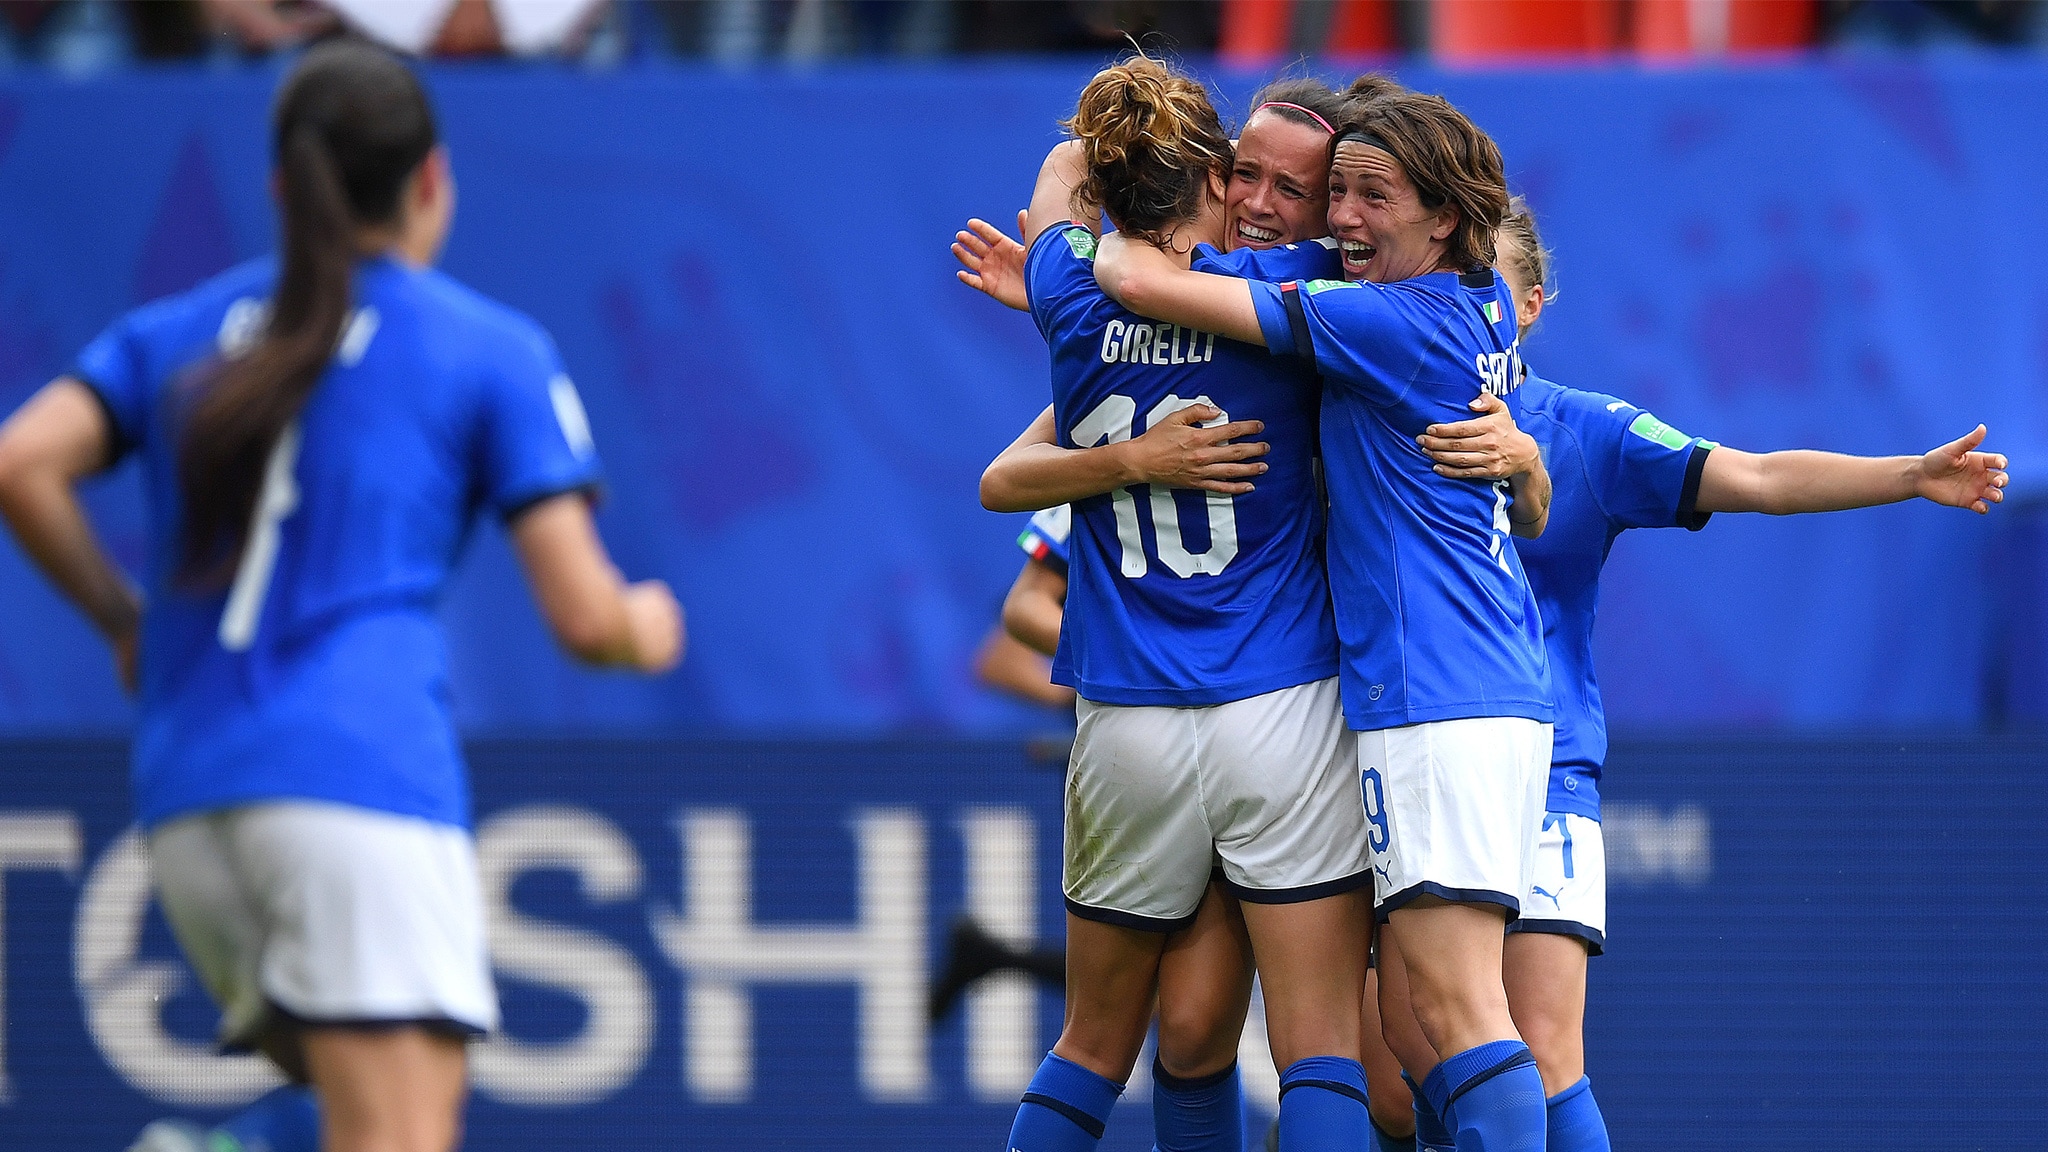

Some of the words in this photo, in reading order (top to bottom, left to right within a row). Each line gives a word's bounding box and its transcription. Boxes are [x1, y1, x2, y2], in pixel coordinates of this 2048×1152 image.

[1100, 319, 1215, 365] GIRELLI
[1070, 394, 1239, 579] 10
[1360, 766, 1391, 856] 9
